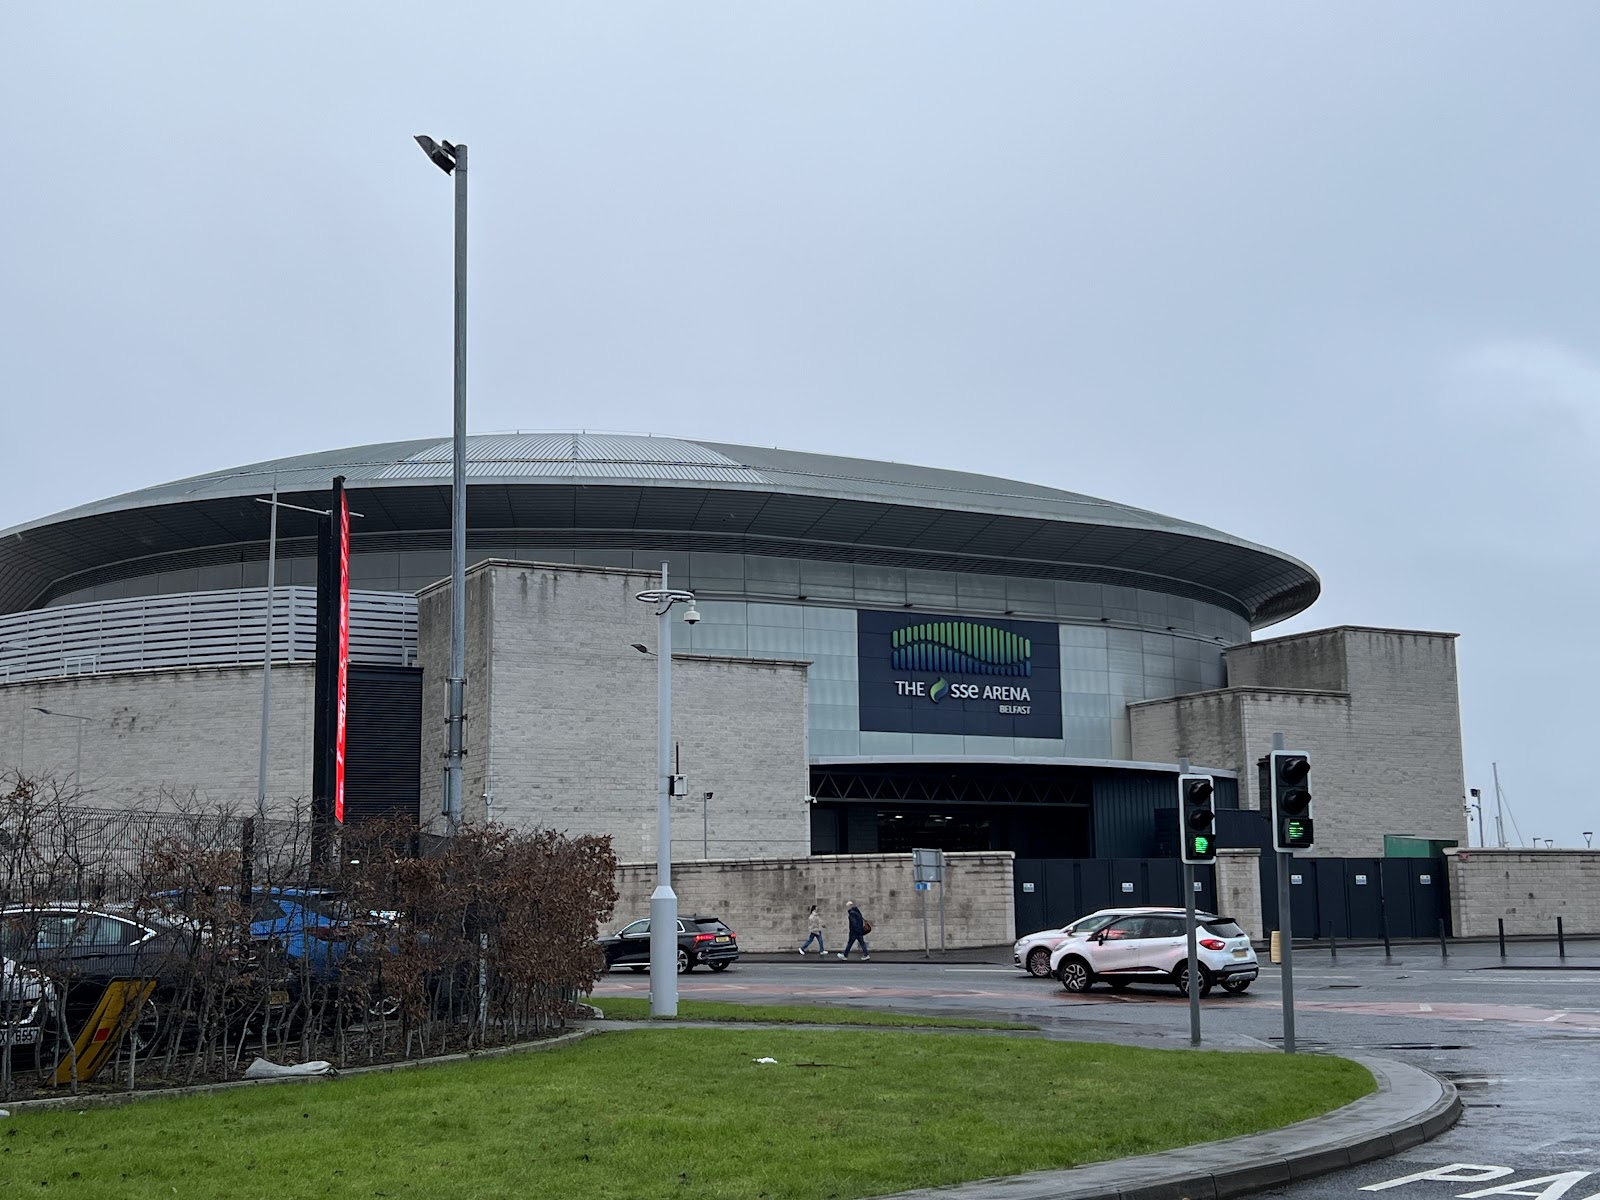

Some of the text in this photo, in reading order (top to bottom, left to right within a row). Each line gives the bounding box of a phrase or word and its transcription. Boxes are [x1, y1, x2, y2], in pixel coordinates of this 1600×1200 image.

[895, 680, 926, 696] THE
[982, 685, 1031, 702] ARENA
[999, 704, 1031, 715] BELFAST
[1357, 1163, 1600, 1200] PA
